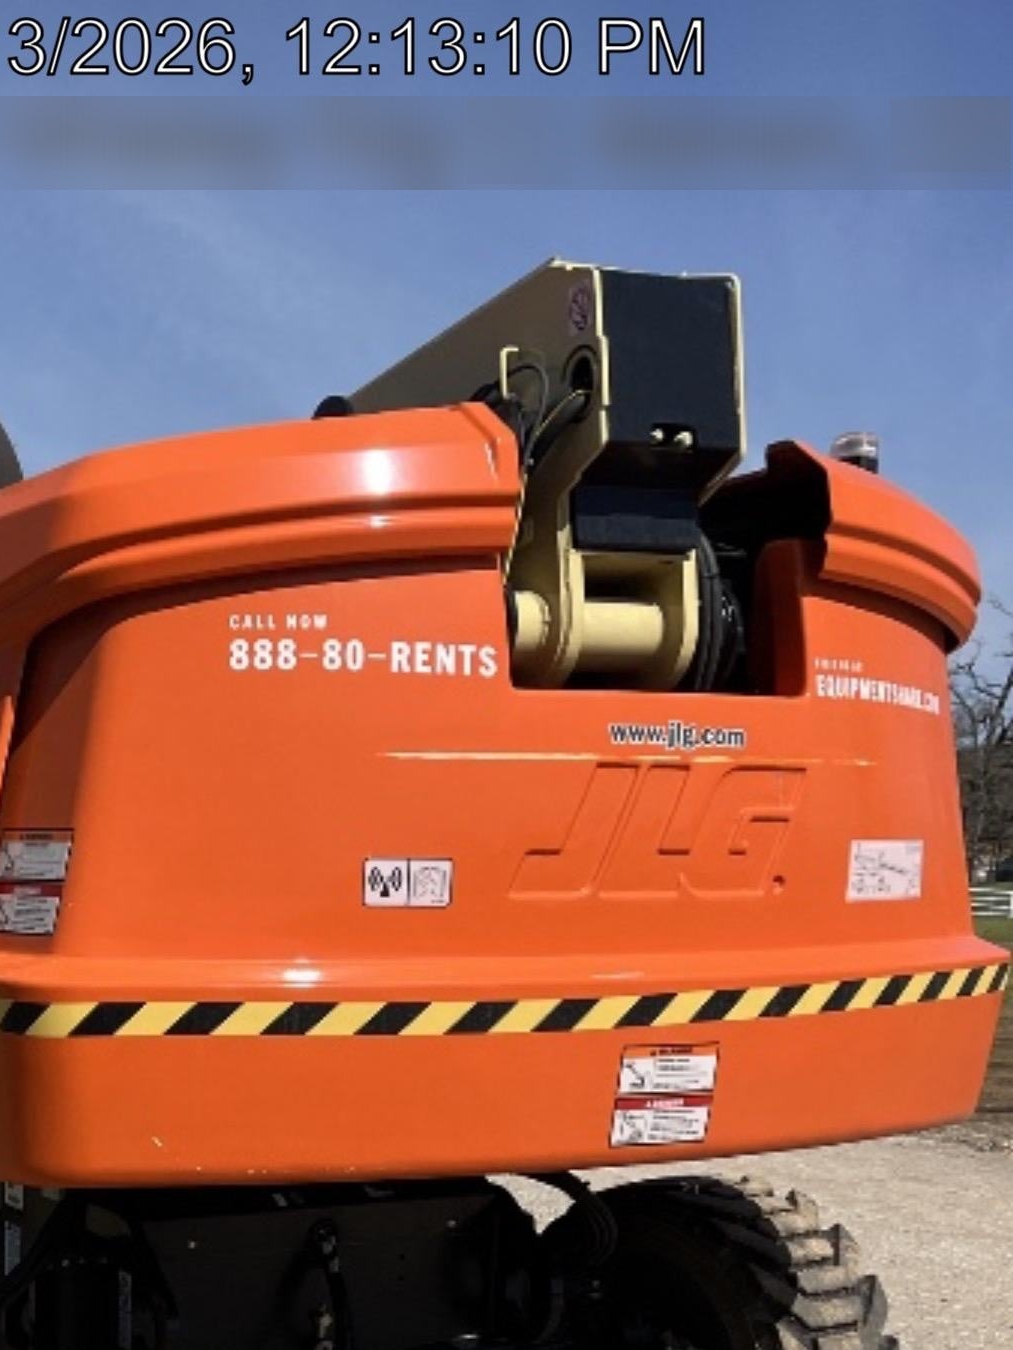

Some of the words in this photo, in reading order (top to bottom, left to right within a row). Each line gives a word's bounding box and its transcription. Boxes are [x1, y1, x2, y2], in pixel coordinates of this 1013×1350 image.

[229, 614, 277, 630] CALL
[286, 614, 328, 630] NOW
[228, 638, 499, 678] 888-80-RENTS
[609, 720, 746, 749] www.jlg.com
[507, 761, 807, 899] JLG
